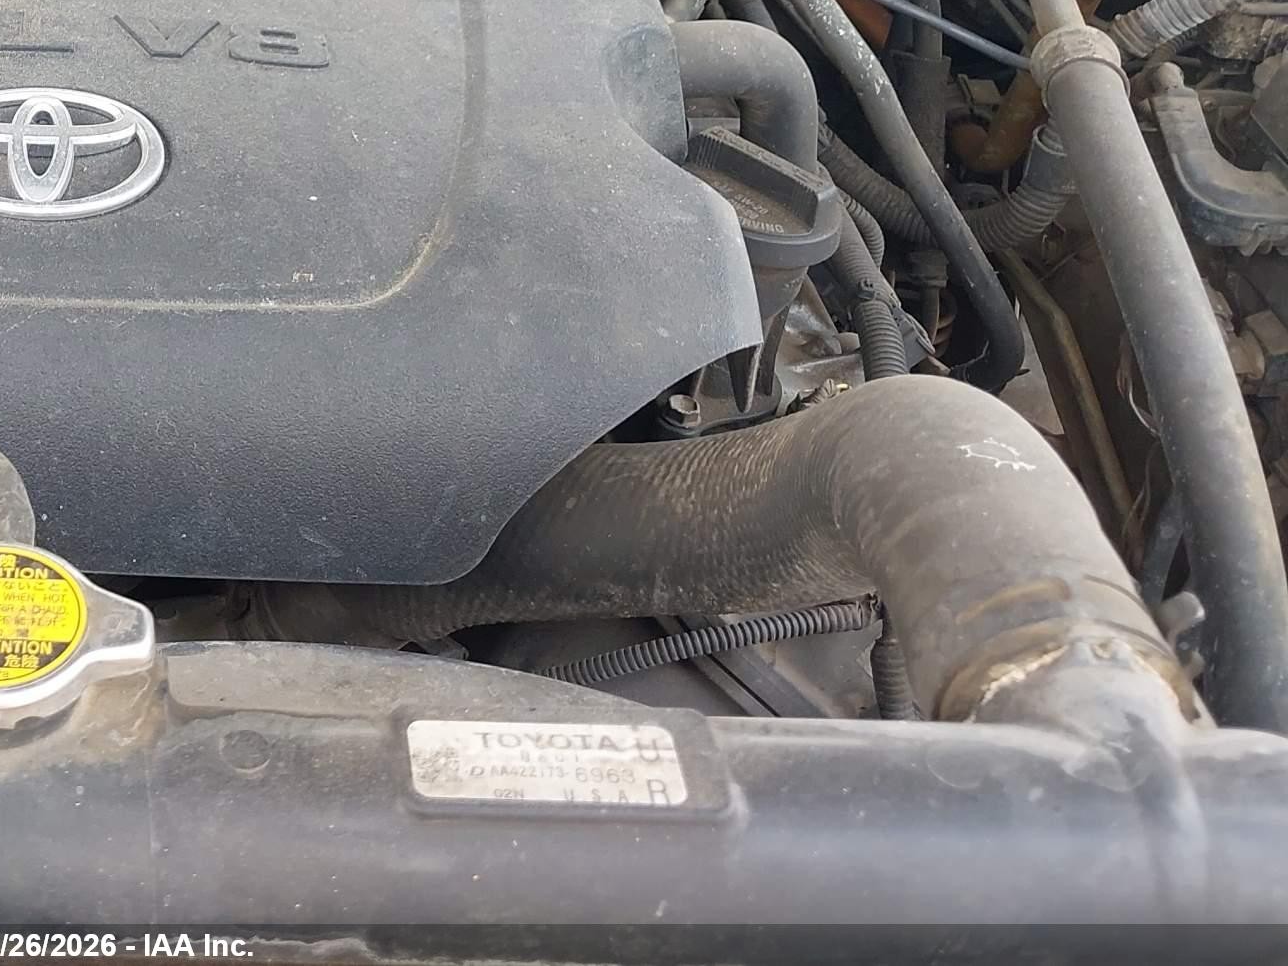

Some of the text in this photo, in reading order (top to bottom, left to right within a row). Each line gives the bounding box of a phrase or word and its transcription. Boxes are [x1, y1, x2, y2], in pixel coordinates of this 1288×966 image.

[113, 14, 330, 68] V8
[3, 592, 35, 602] WHEN
[472, 731, 621, 751] TOYOTA
[646, 778, 670, 804] R
